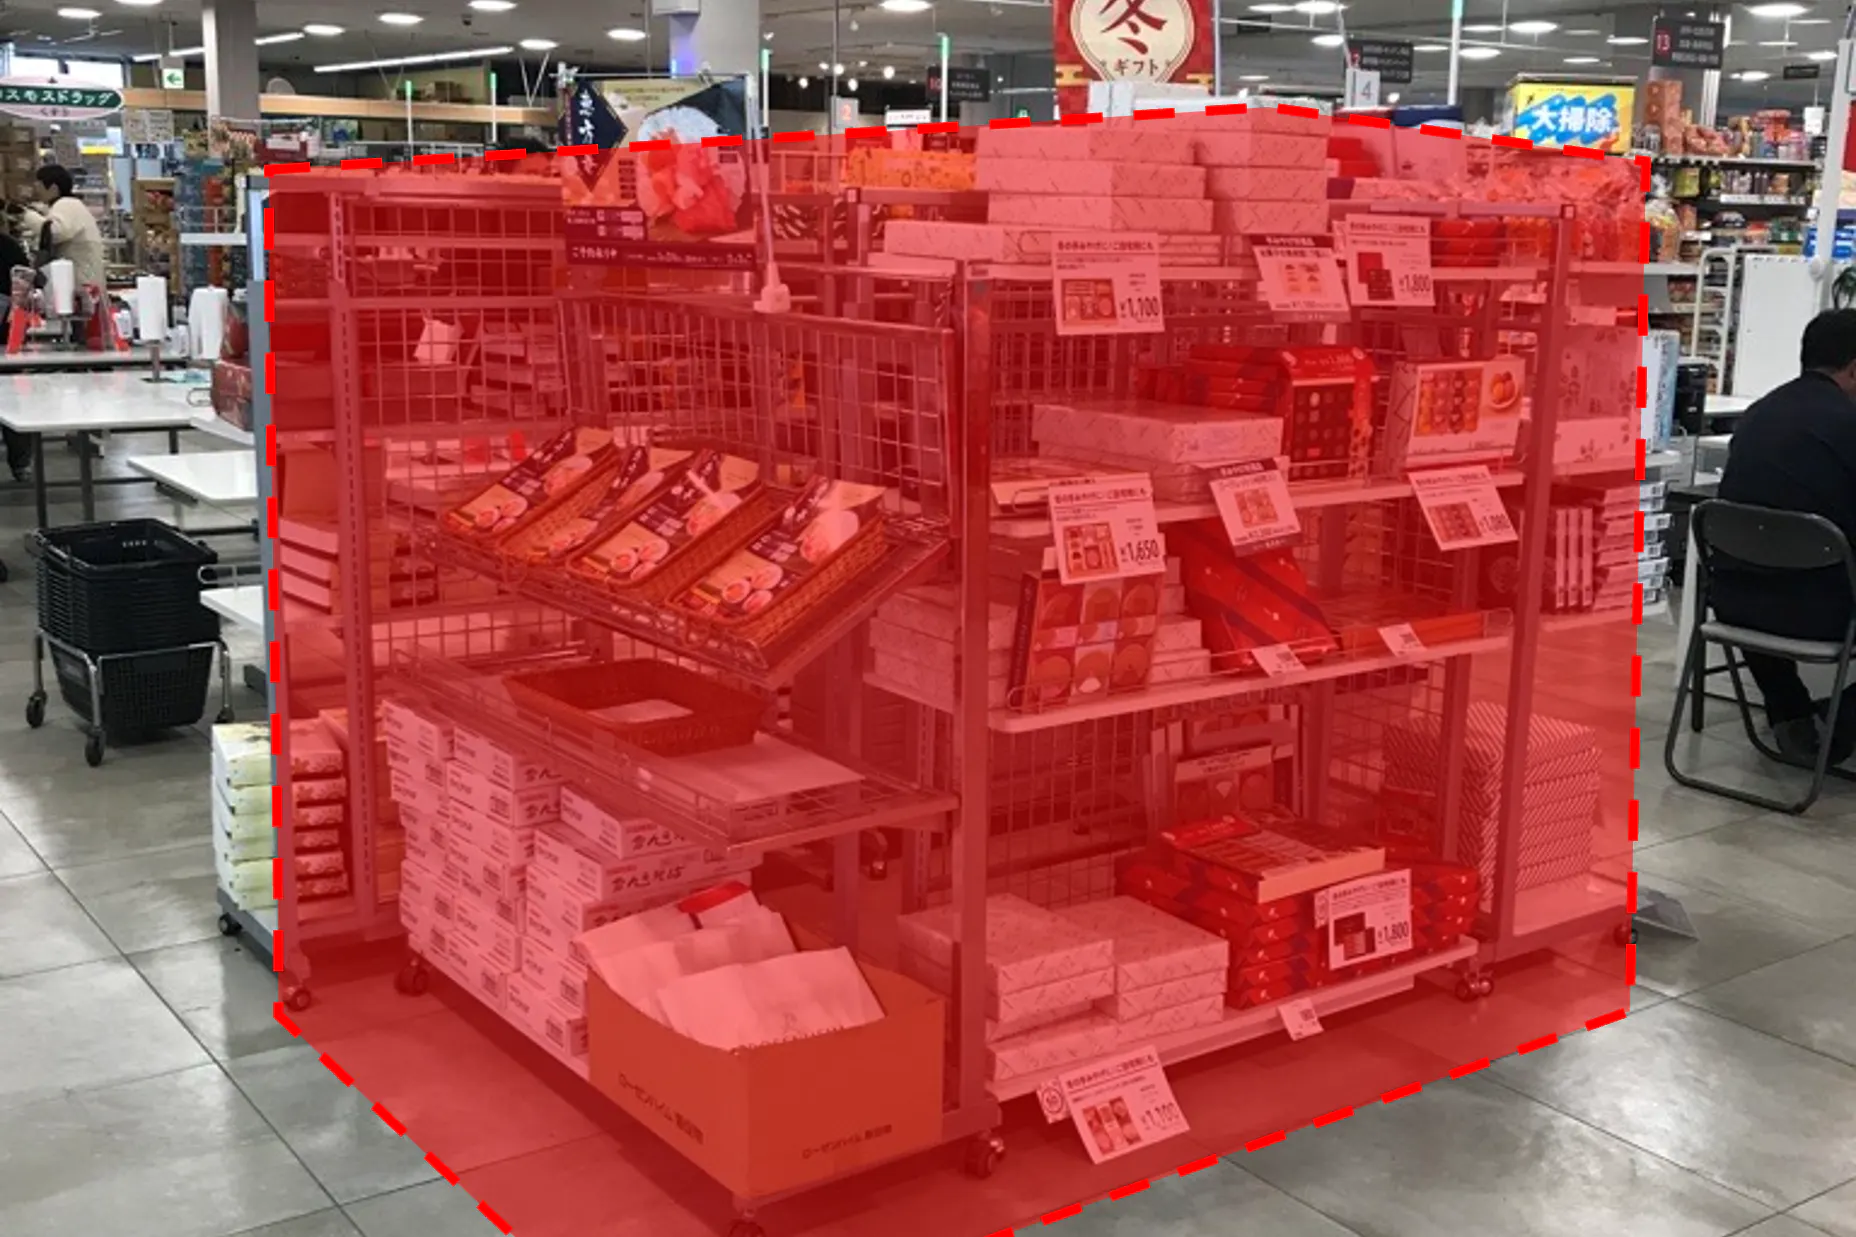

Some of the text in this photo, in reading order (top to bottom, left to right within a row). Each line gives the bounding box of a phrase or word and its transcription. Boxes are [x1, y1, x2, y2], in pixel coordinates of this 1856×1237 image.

[1099, 0, 1168, 55] 冬
[1114, 59, 1159, 76] ギフト
[1361, 80, 1373, 101] 4
[1531, 104, 1613, 133] 大掃除
